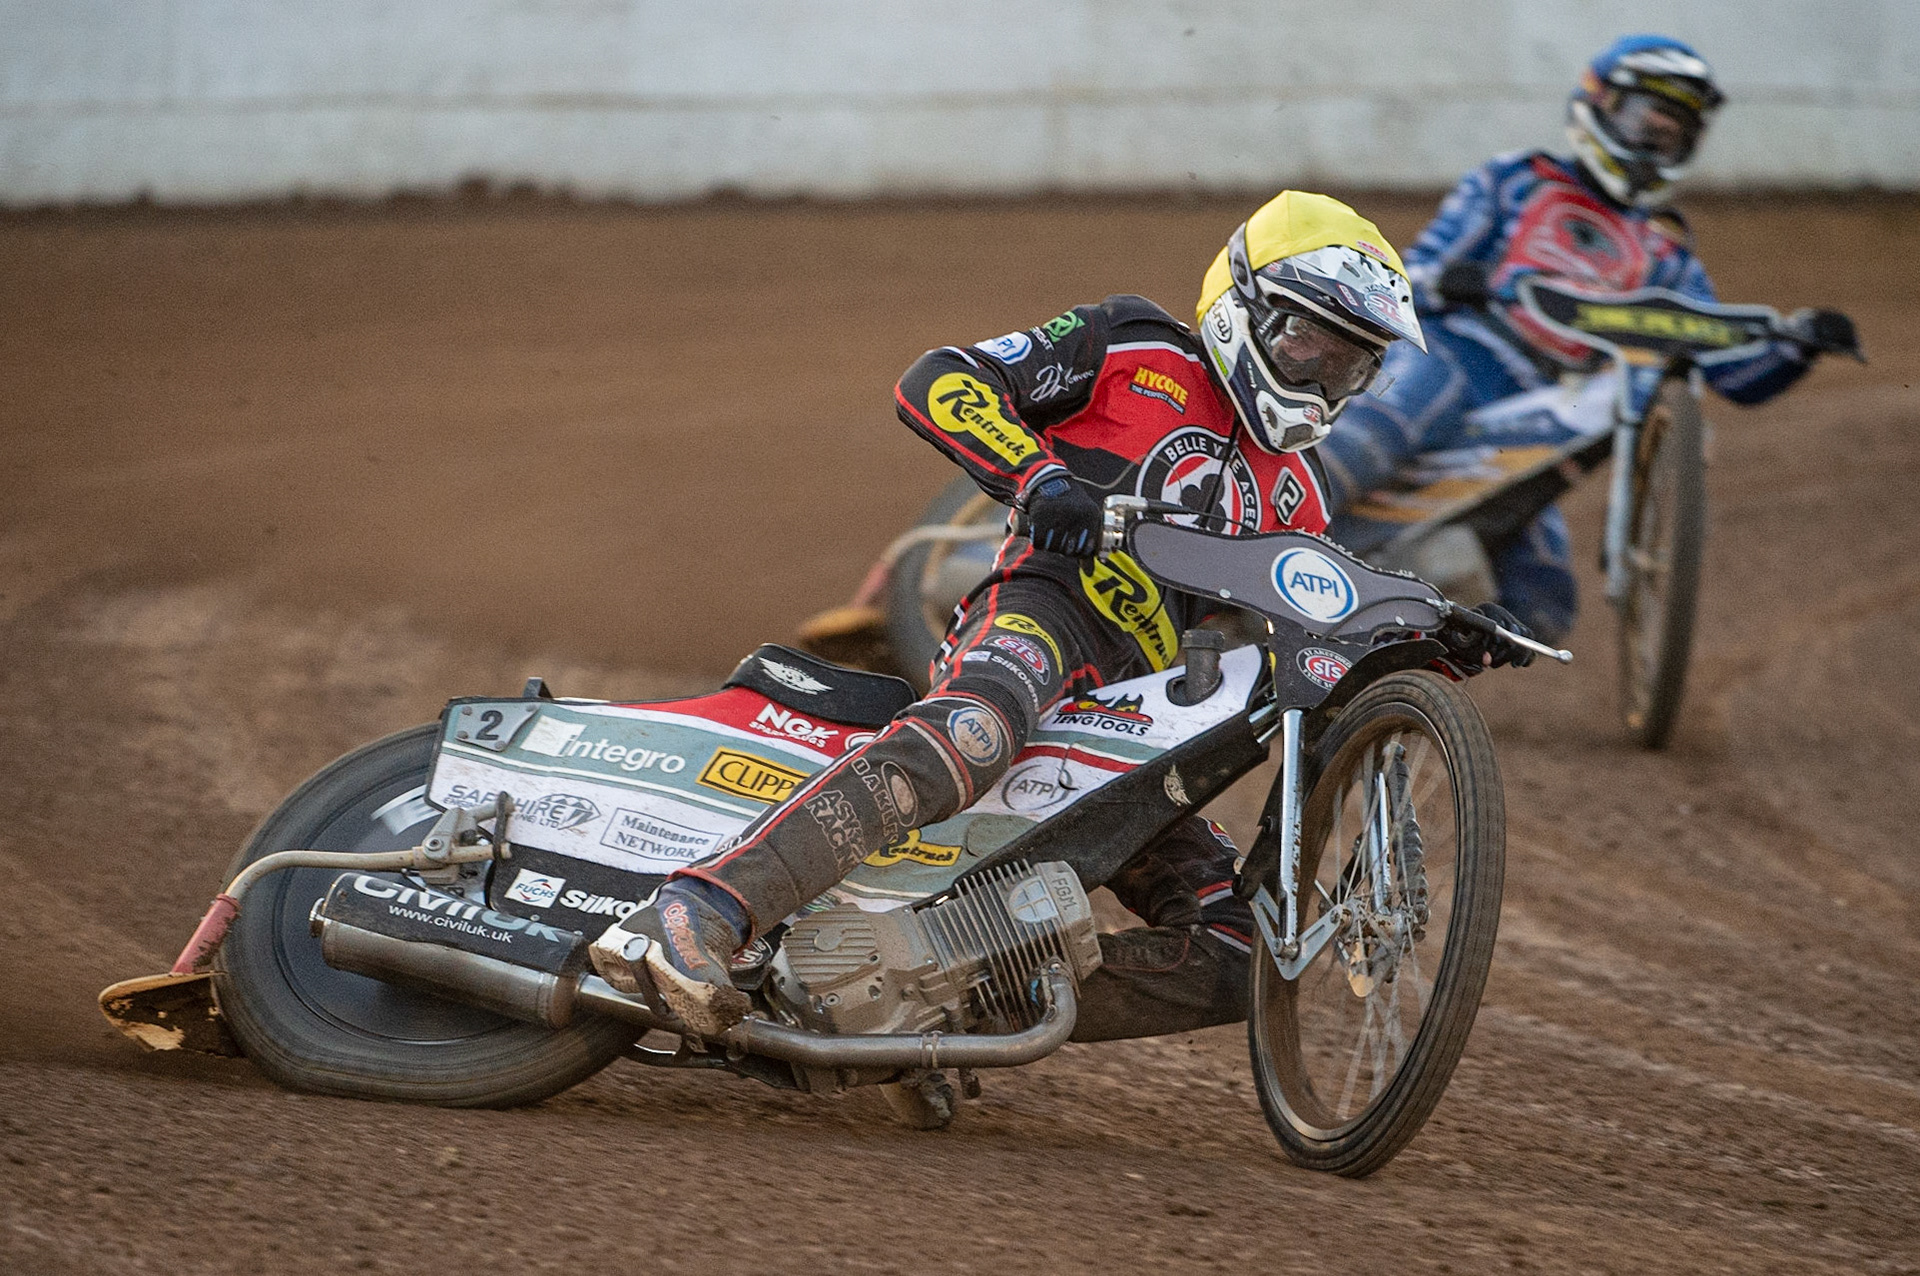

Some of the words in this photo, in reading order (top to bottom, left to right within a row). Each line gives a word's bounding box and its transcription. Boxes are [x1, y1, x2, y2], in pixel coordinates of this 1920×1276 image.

[1134, 367, 1188, 405] HYCOTE
[936, 379, 1025, 457] Rentruck
[1164, 437, 1207, 462] BELLE
[1213, 443, 1243, 474] VE
[1239, 481, 1257, 531] ACES
[1290, 571, 1340, 598] ATPI
[1002, 640, 1039, 664] STS
[1312, 659, 1342, 679] STS
[475, 710, 504, 741] 2
[756, 703, 839, 739] NGK
[959, 718, 993, 751] ATPI
[561, 735, 686, 774] integro
[719, 760, 795, 795] CLIPP
[1012, 779, 1060, 799] ATPI
[449, 784, 567, 821] SAPHIRE
[538, 817, 559, 829] LTD
[621, 814, 710, 846] Maintenance
[614, 831, 700, 859] NETWORK
[515, 883, 557, 899] FUCHS
[560, 889, 637, 920] Silko
[387, 904, 514, 944] www.civiluk.uk
